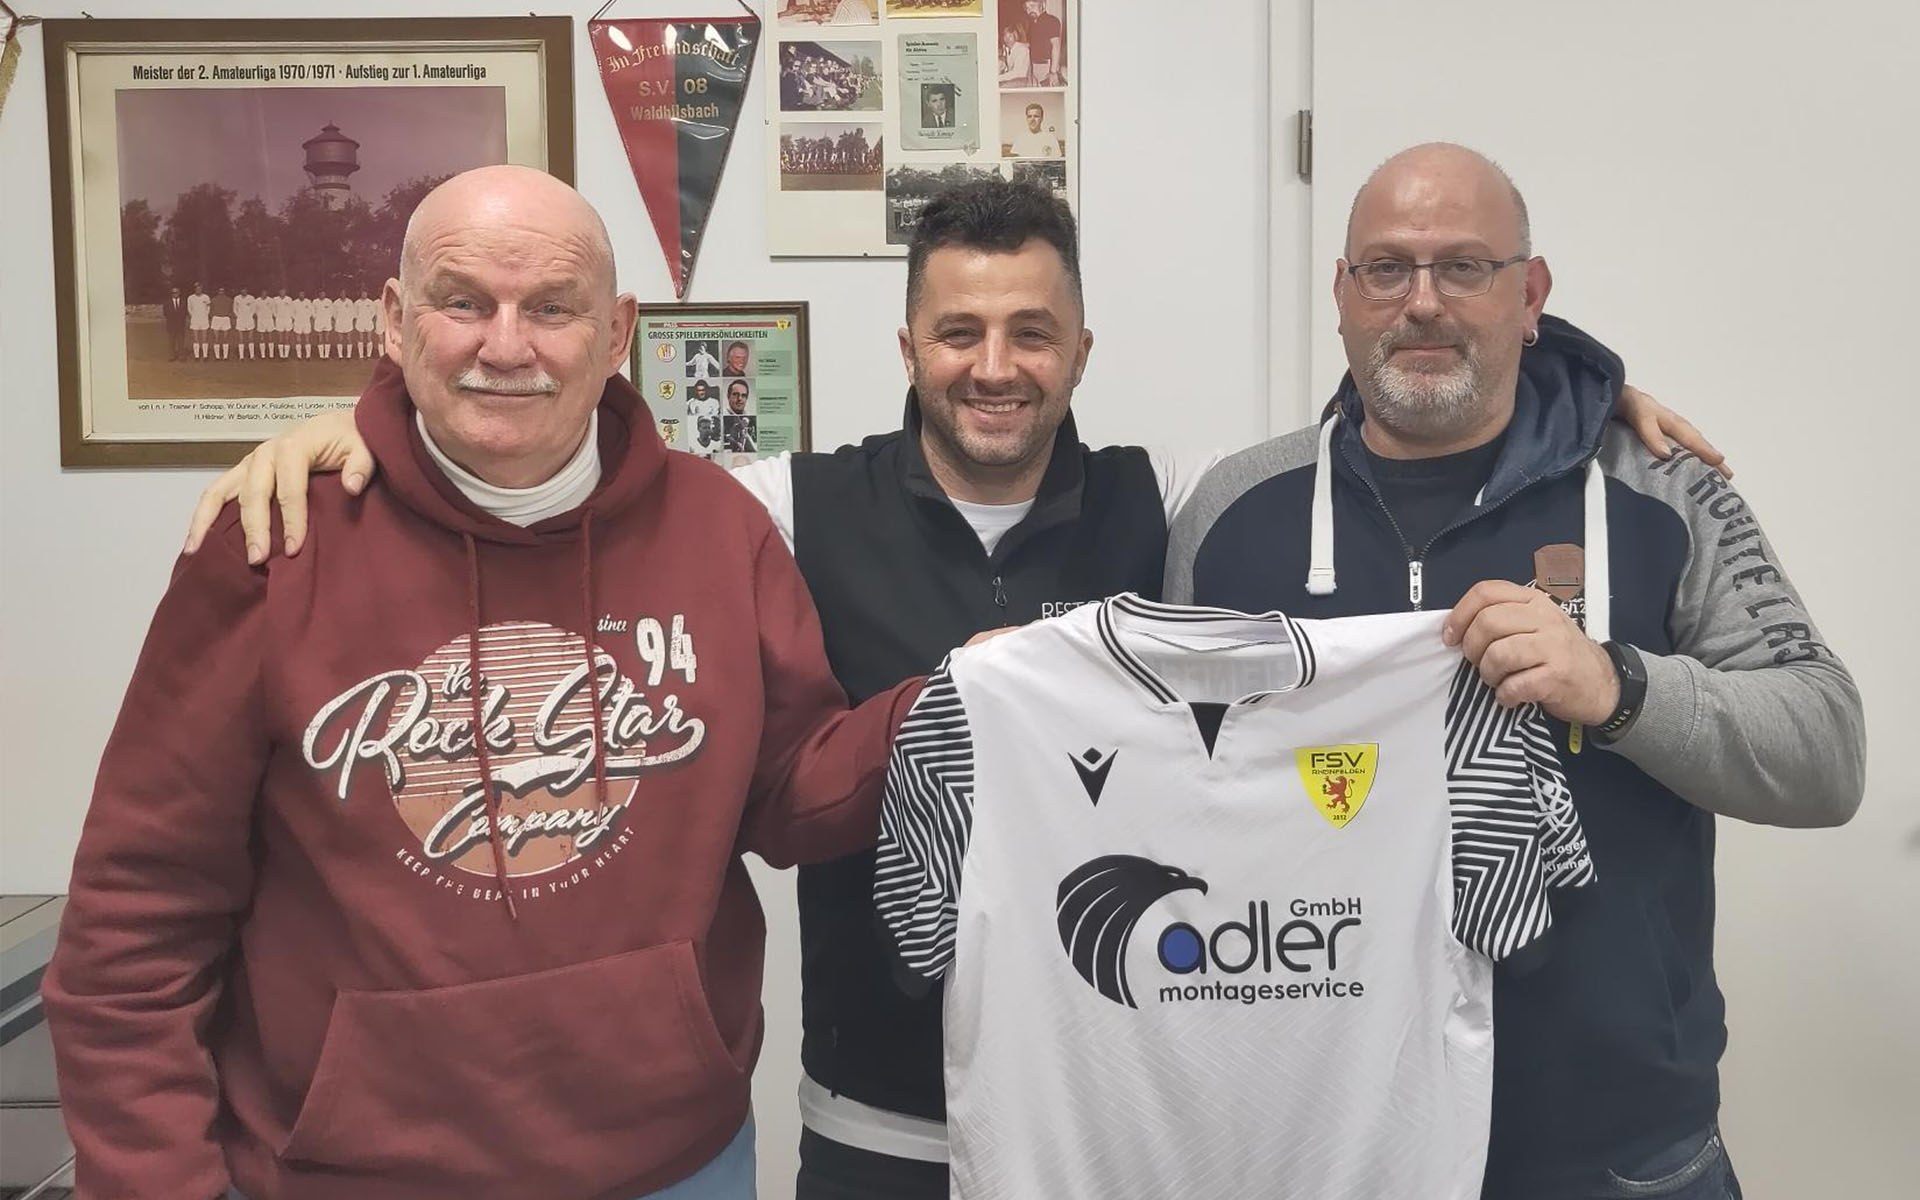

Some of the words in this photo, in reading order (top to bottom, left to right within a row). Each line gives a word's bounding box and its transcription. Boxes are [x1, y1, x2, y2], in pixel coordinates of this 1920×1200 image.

[133, 65, 174, 80] Meister
[177, 65, 195, 80] der
[198, 65, 210, 79] 2.
[213, 64, 276, 82] Amateurliga
[279, 64, 335, 80] 1970/1971
[345, 64, 389, 81] Aufstieg
[392, 68, 410, 80] zur
[412, 65, 421, 79] 1.
[423, 64, 486, 81] Amateurliga
[684, 78, 708, 95] 08
[648, 331, 674, 340] GROSSE
[597, 613, 629, 632] since
[636, 614, 697, 686] 94
[442, 660, 488, 696] the
[303, 669, 514, 800] Rock
[533, 653, 706, 790] Star
[1311, 752, 1364, 768] FSV
[423, 786, 624, 860] Company
[396, 848, 430, 877] KEEP
[435, 874, 464, 896] THE
[472, 888, 513, 901] BEA
[523, 887, 540, 899] IN
[595, 826, 635, 868] HEART
[1290, 897, 1361, 917] GmbH
[1157, 900, 1361, 974] adler
[1160, 977, 1364, 1005] montageservice
